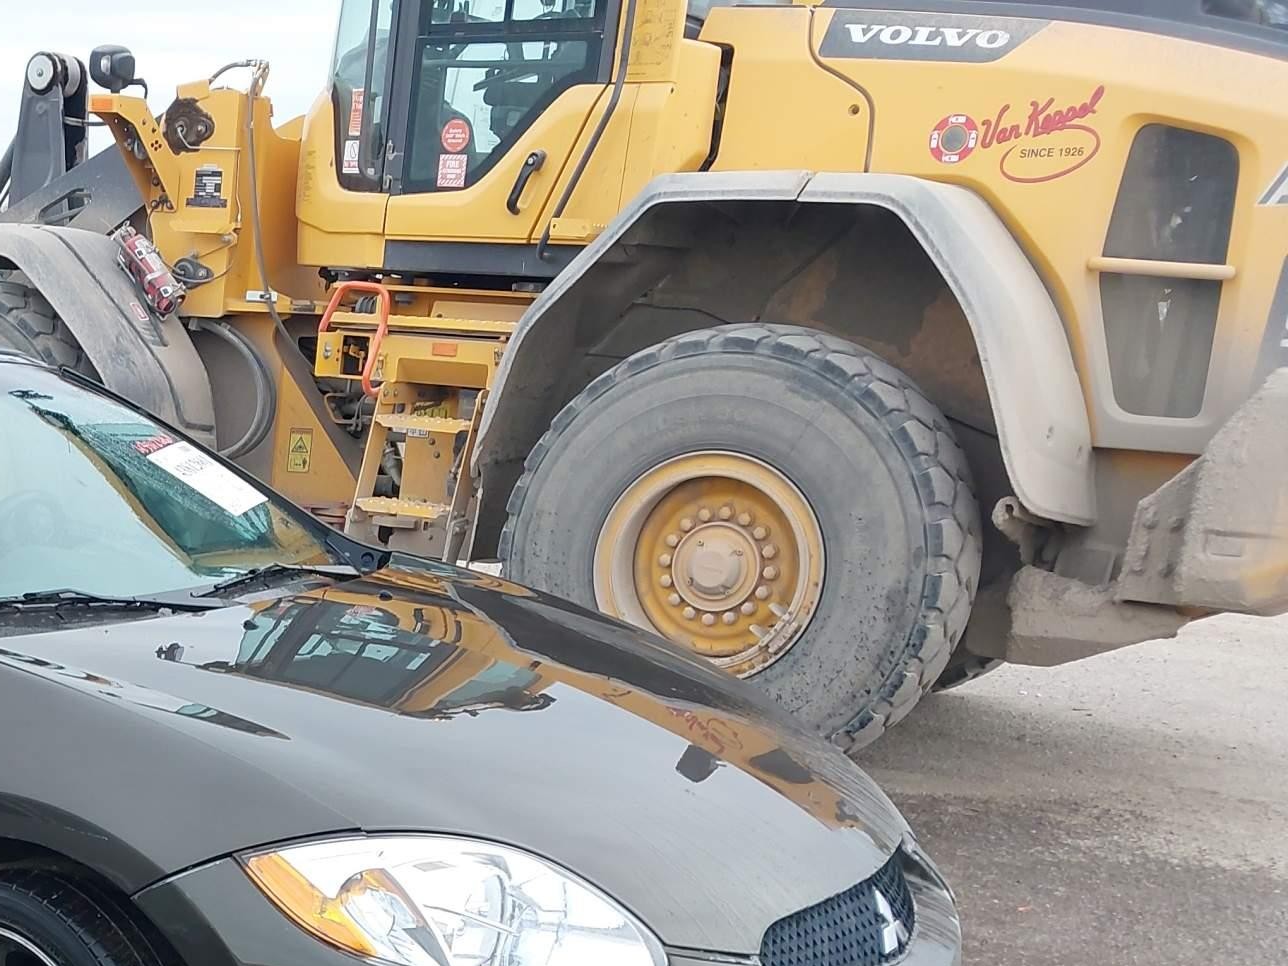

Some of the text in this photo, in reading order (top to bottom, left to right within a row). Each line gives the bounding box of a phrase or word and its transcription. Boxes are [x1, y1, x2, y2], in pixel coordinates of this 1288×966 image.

[844, 23, 1010, 49] VOLVO
[980, 103, 1022, 149] Van
[1019, 146, 1085, 159] SINCE 1926
